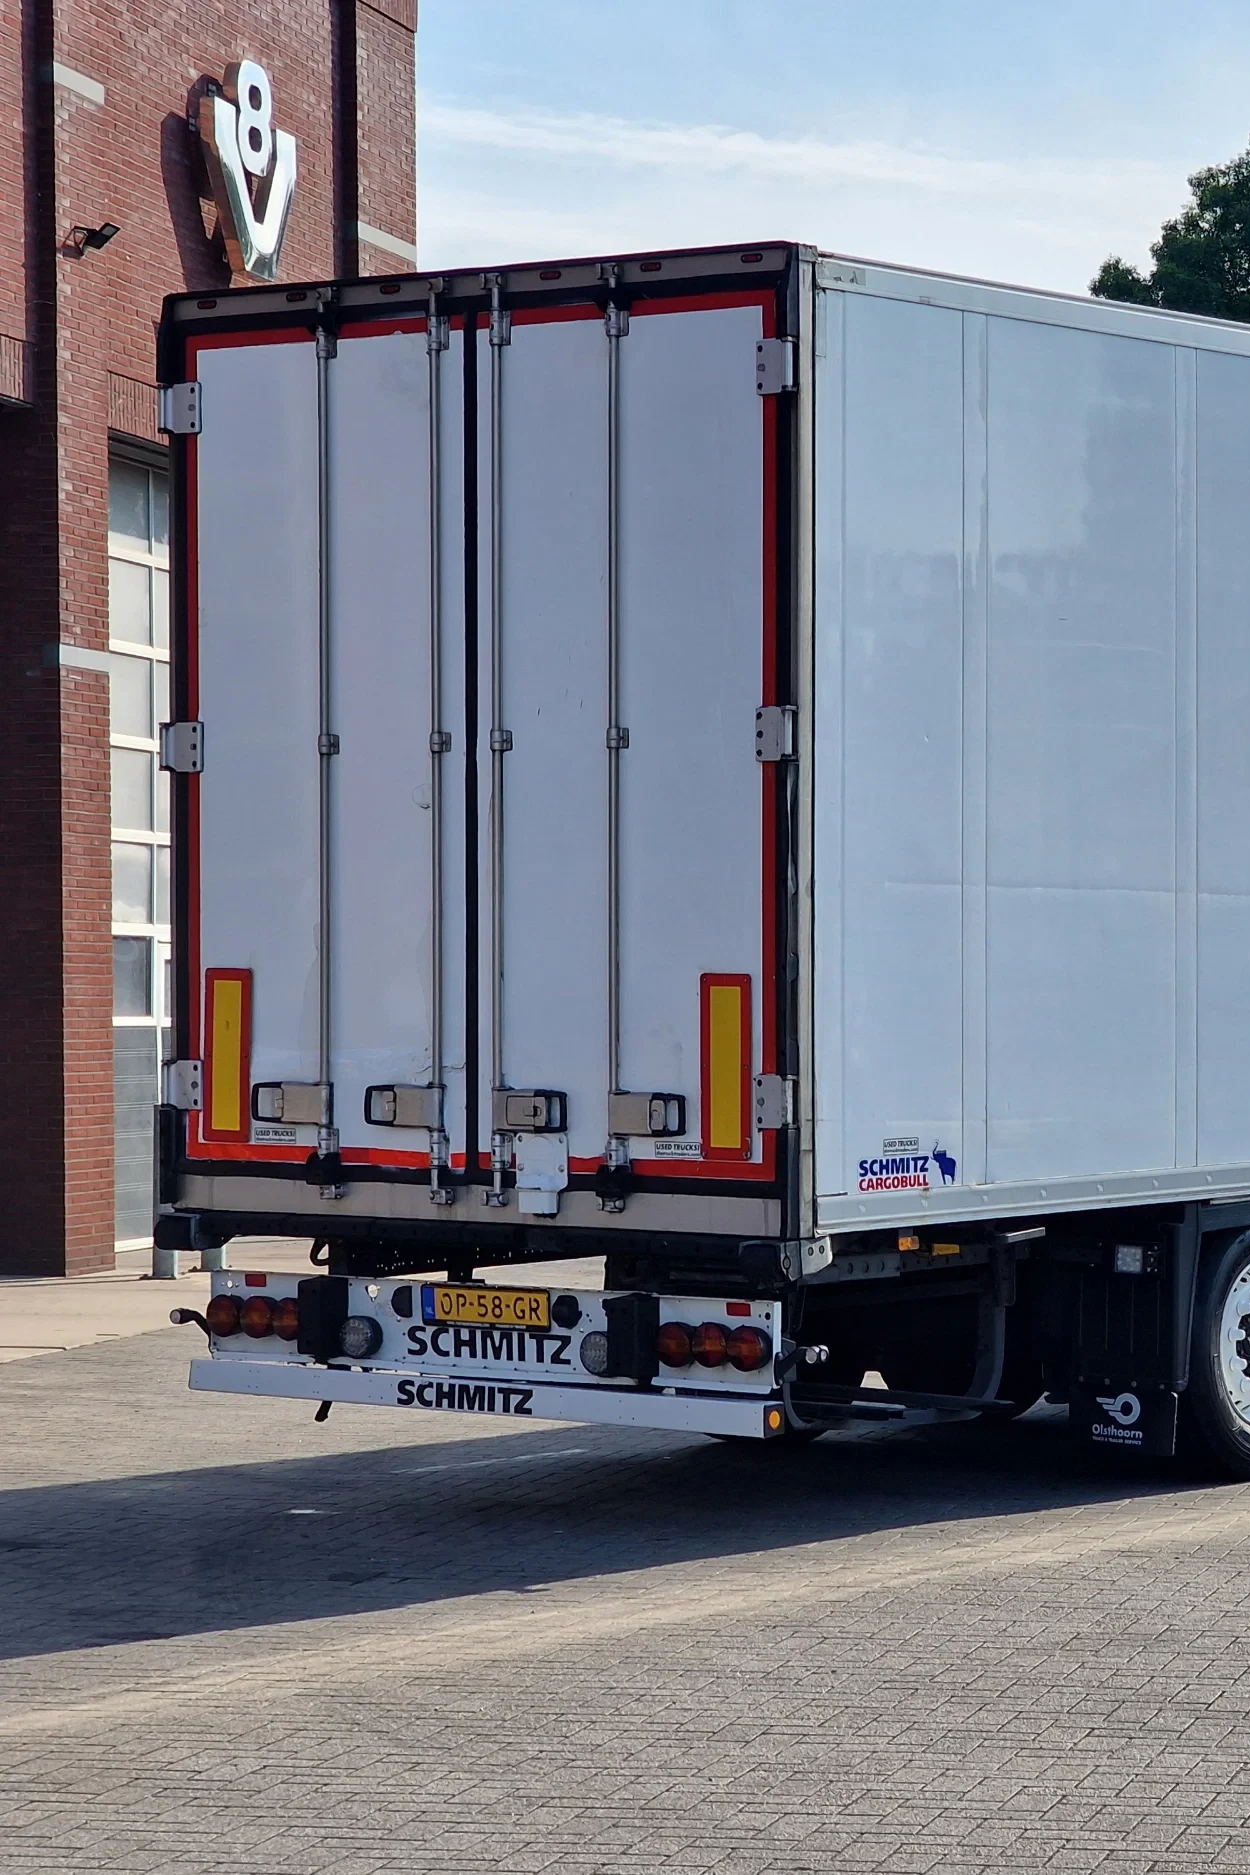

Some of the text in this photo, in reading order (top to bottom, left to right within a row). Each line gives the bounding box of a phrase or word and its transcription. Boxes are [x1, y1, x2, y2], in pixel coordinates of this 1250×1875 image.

[858, 1155, 930, 1177] SCHMITZ
[858, 1173, 930, 1192] CARGOBULL
[407, 1325, 572, 1366] SCHMITZ
[396, 1379, 534, 1415] SCHMITZ
[1091, 1423, 1143, 1439] Olsthoorn
